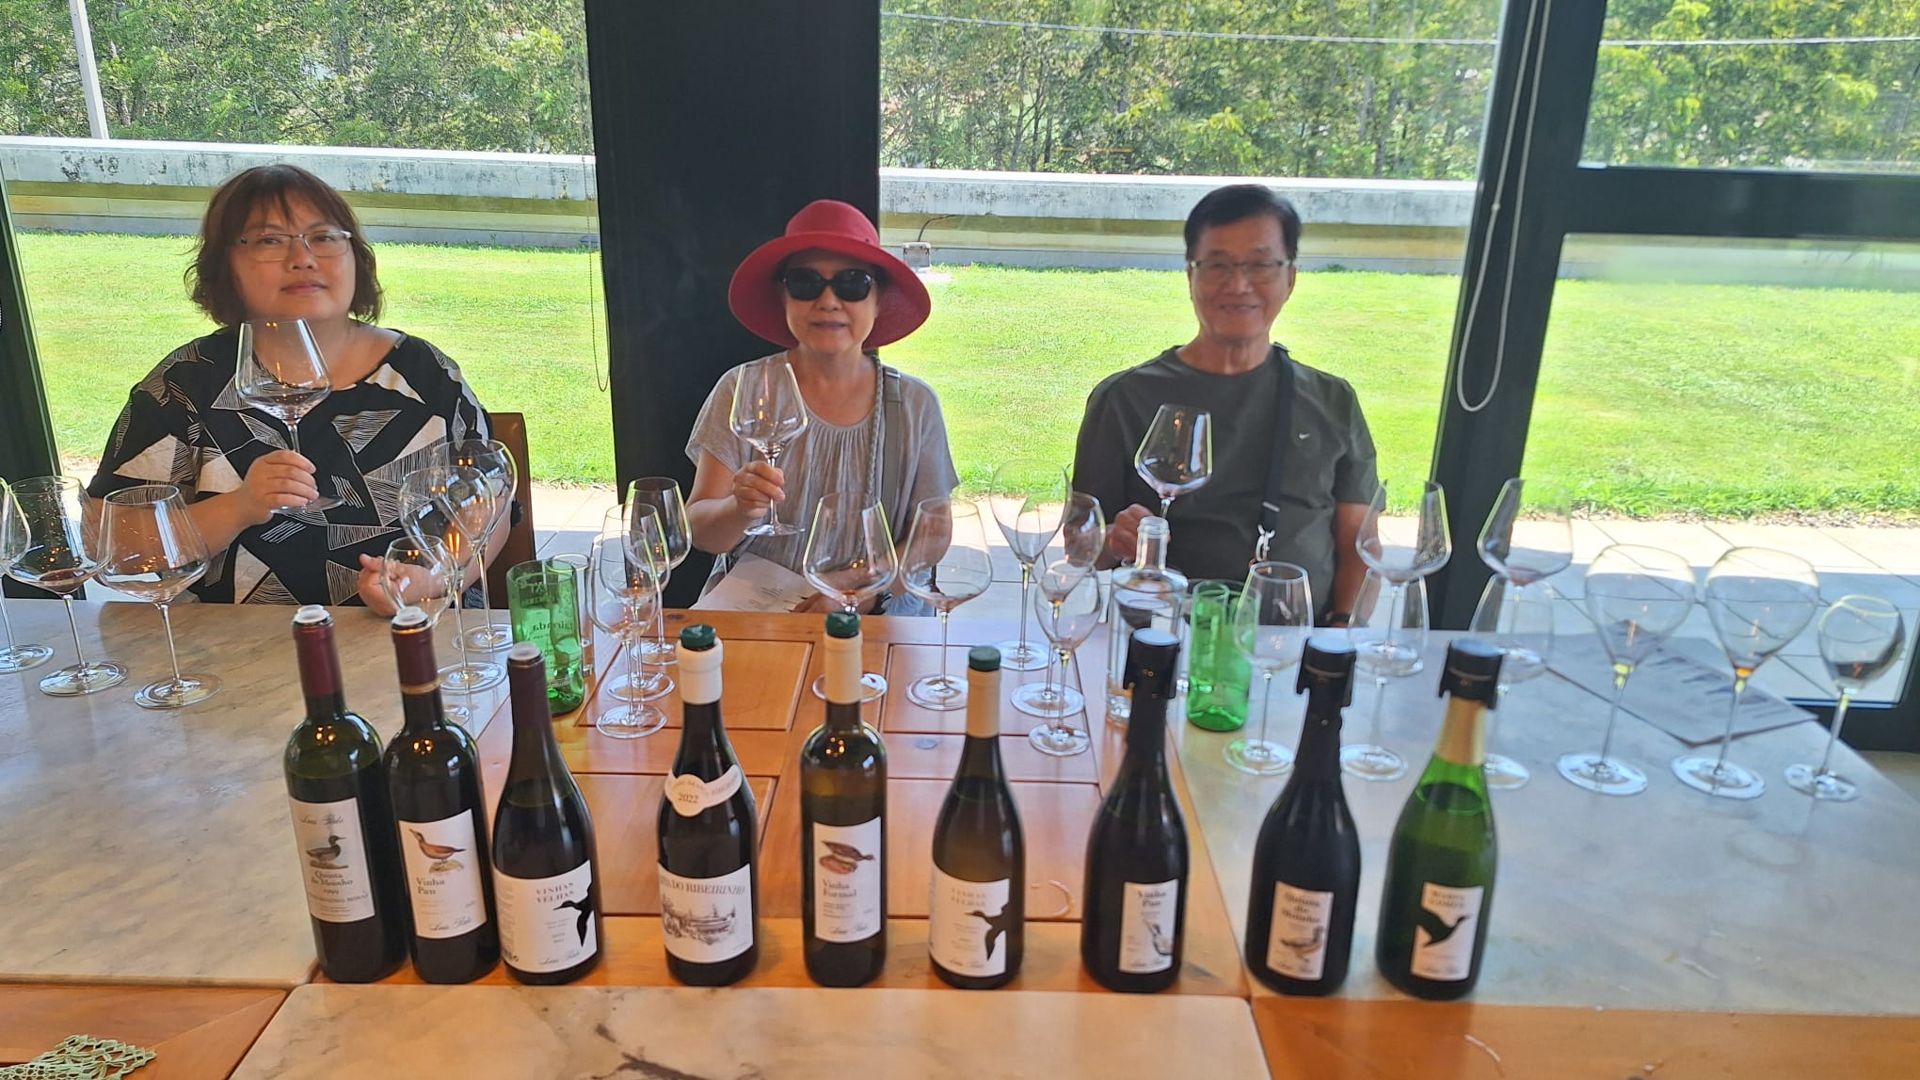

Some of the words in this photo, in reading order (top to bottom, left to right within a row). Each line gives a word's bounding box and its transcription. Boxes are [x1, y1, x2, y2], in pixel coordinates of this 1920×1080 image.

[678, 792, 699, 804] 2022
[416, 876, 446, 887] Vinha
[536, 882, 574, 895] VINHAS
[686, 881, 746, 896] RIBEIRINHO
[537, 890, 575, 904] VELHAS
